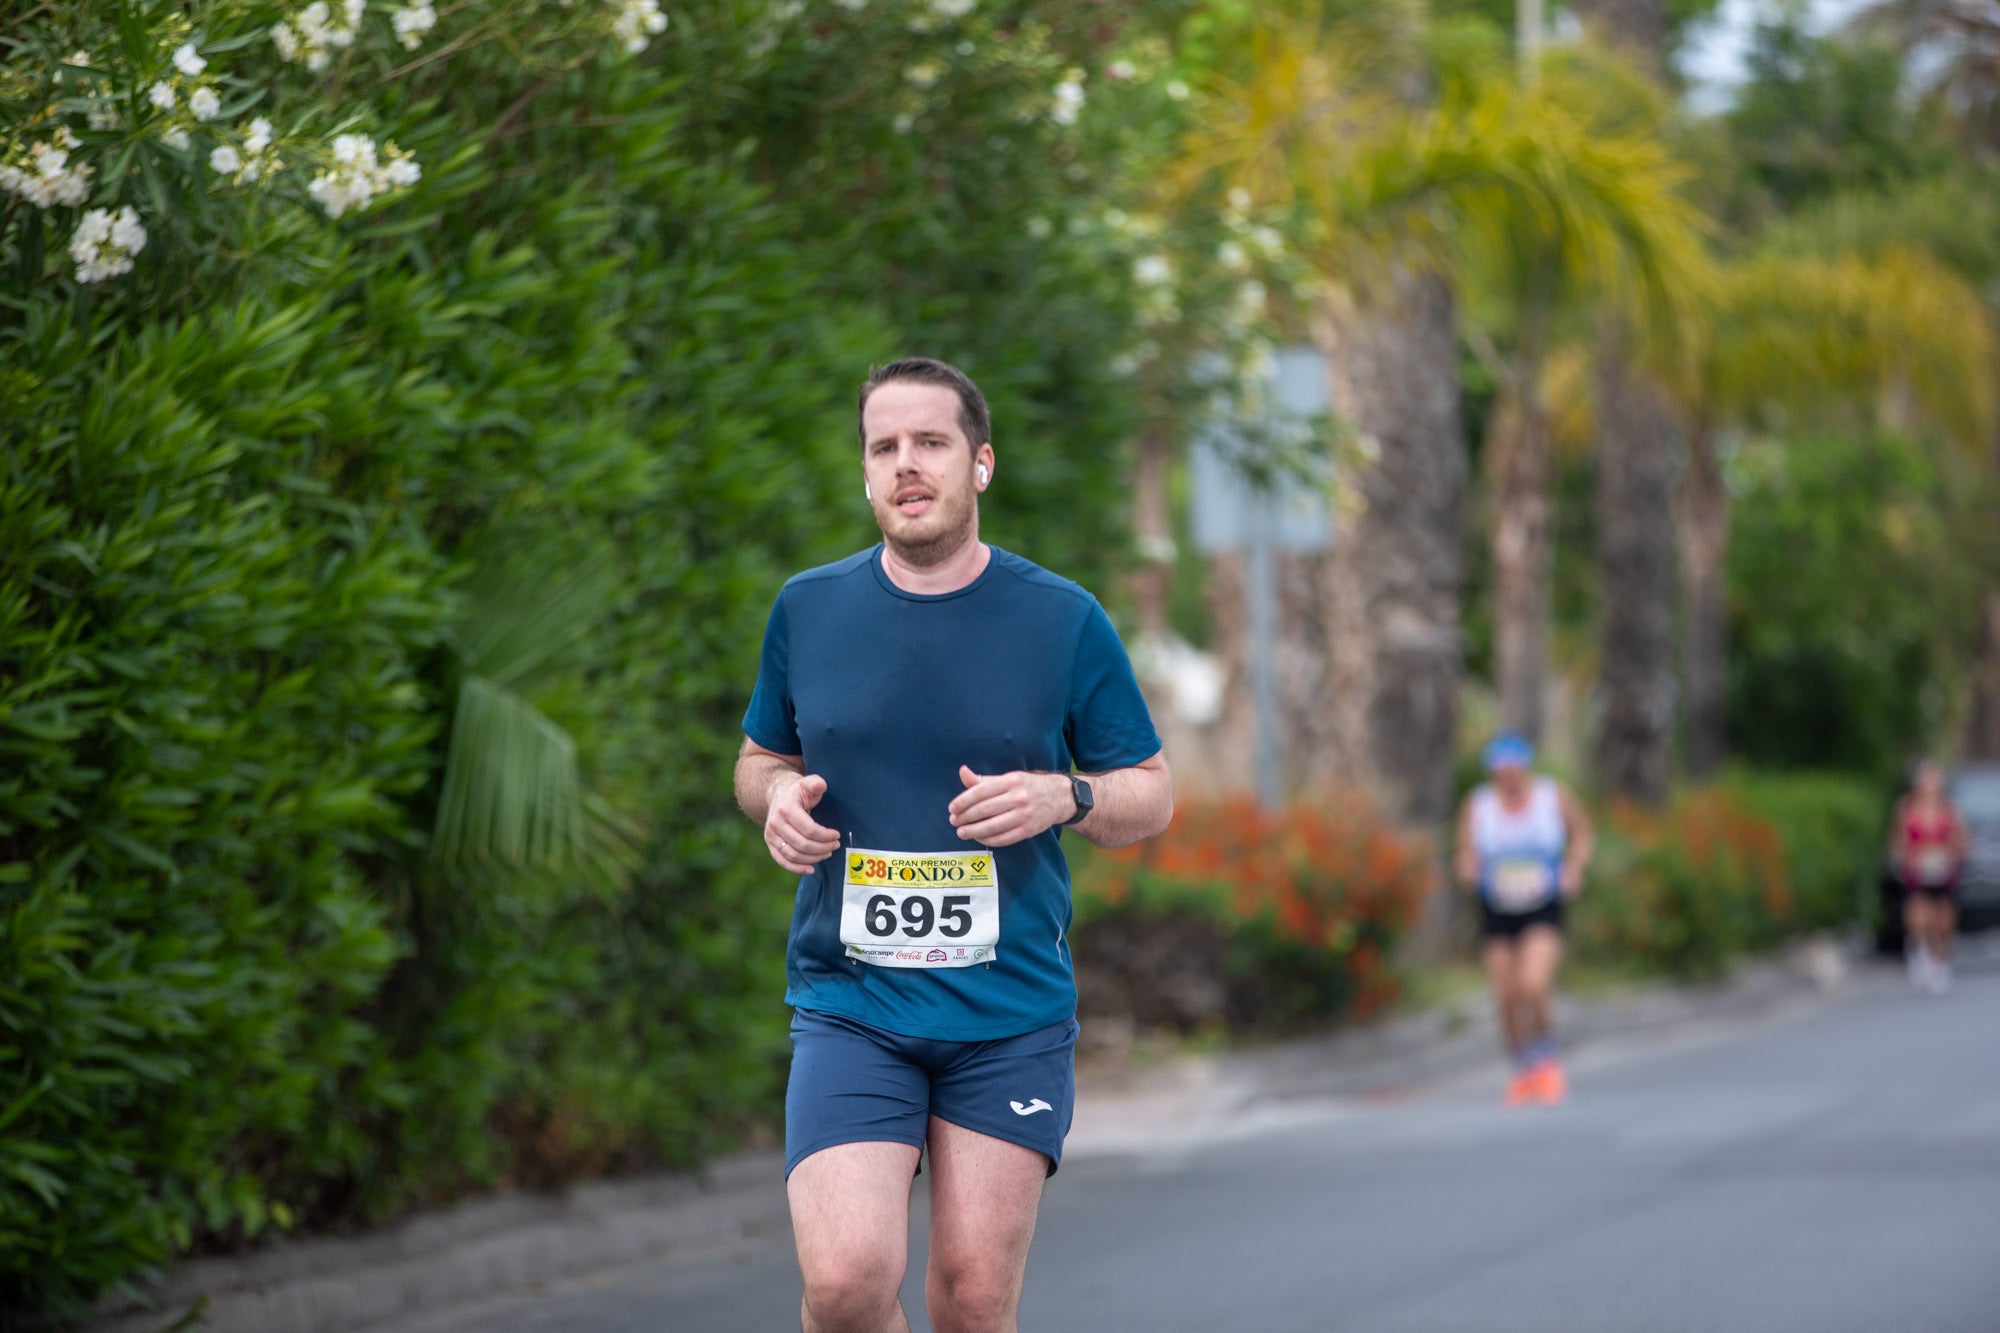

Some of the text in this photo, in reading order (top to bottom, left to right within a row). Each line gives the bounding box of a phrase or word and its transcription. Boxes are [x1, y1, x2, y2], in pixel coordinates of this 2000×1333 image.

[865, 858, 887, 878] 38
[888, 866, 964, 881] FONDO
[865, 894, 973, 938] 695
